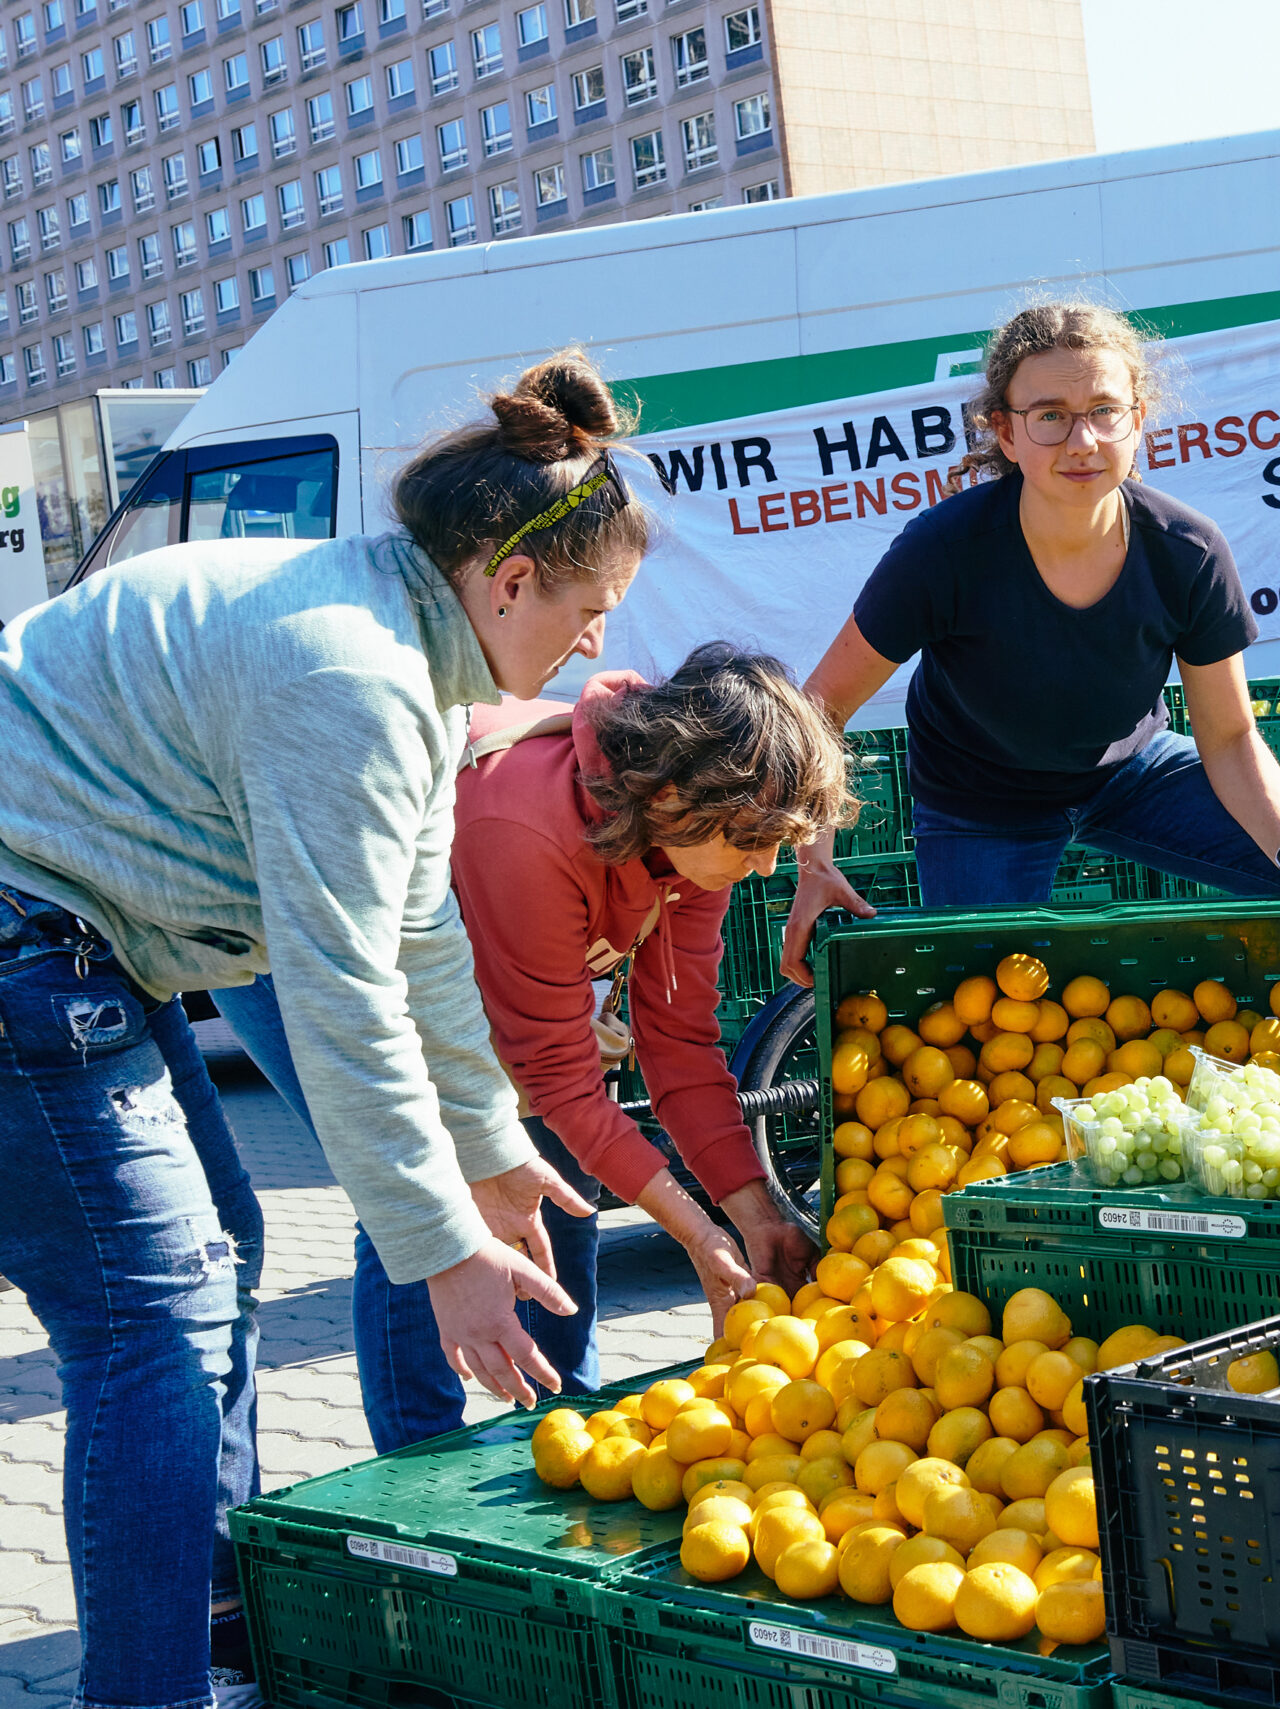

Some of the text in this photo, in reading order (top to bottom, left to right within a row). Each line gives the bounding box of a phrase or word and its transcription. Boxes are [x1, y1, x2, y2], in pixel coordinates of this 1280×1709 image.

[647, 402, 978, 496] WIR HAB
[1103, 1212, 1127, 1224] 24603
[753, 1627, 778, 1642] 24603
